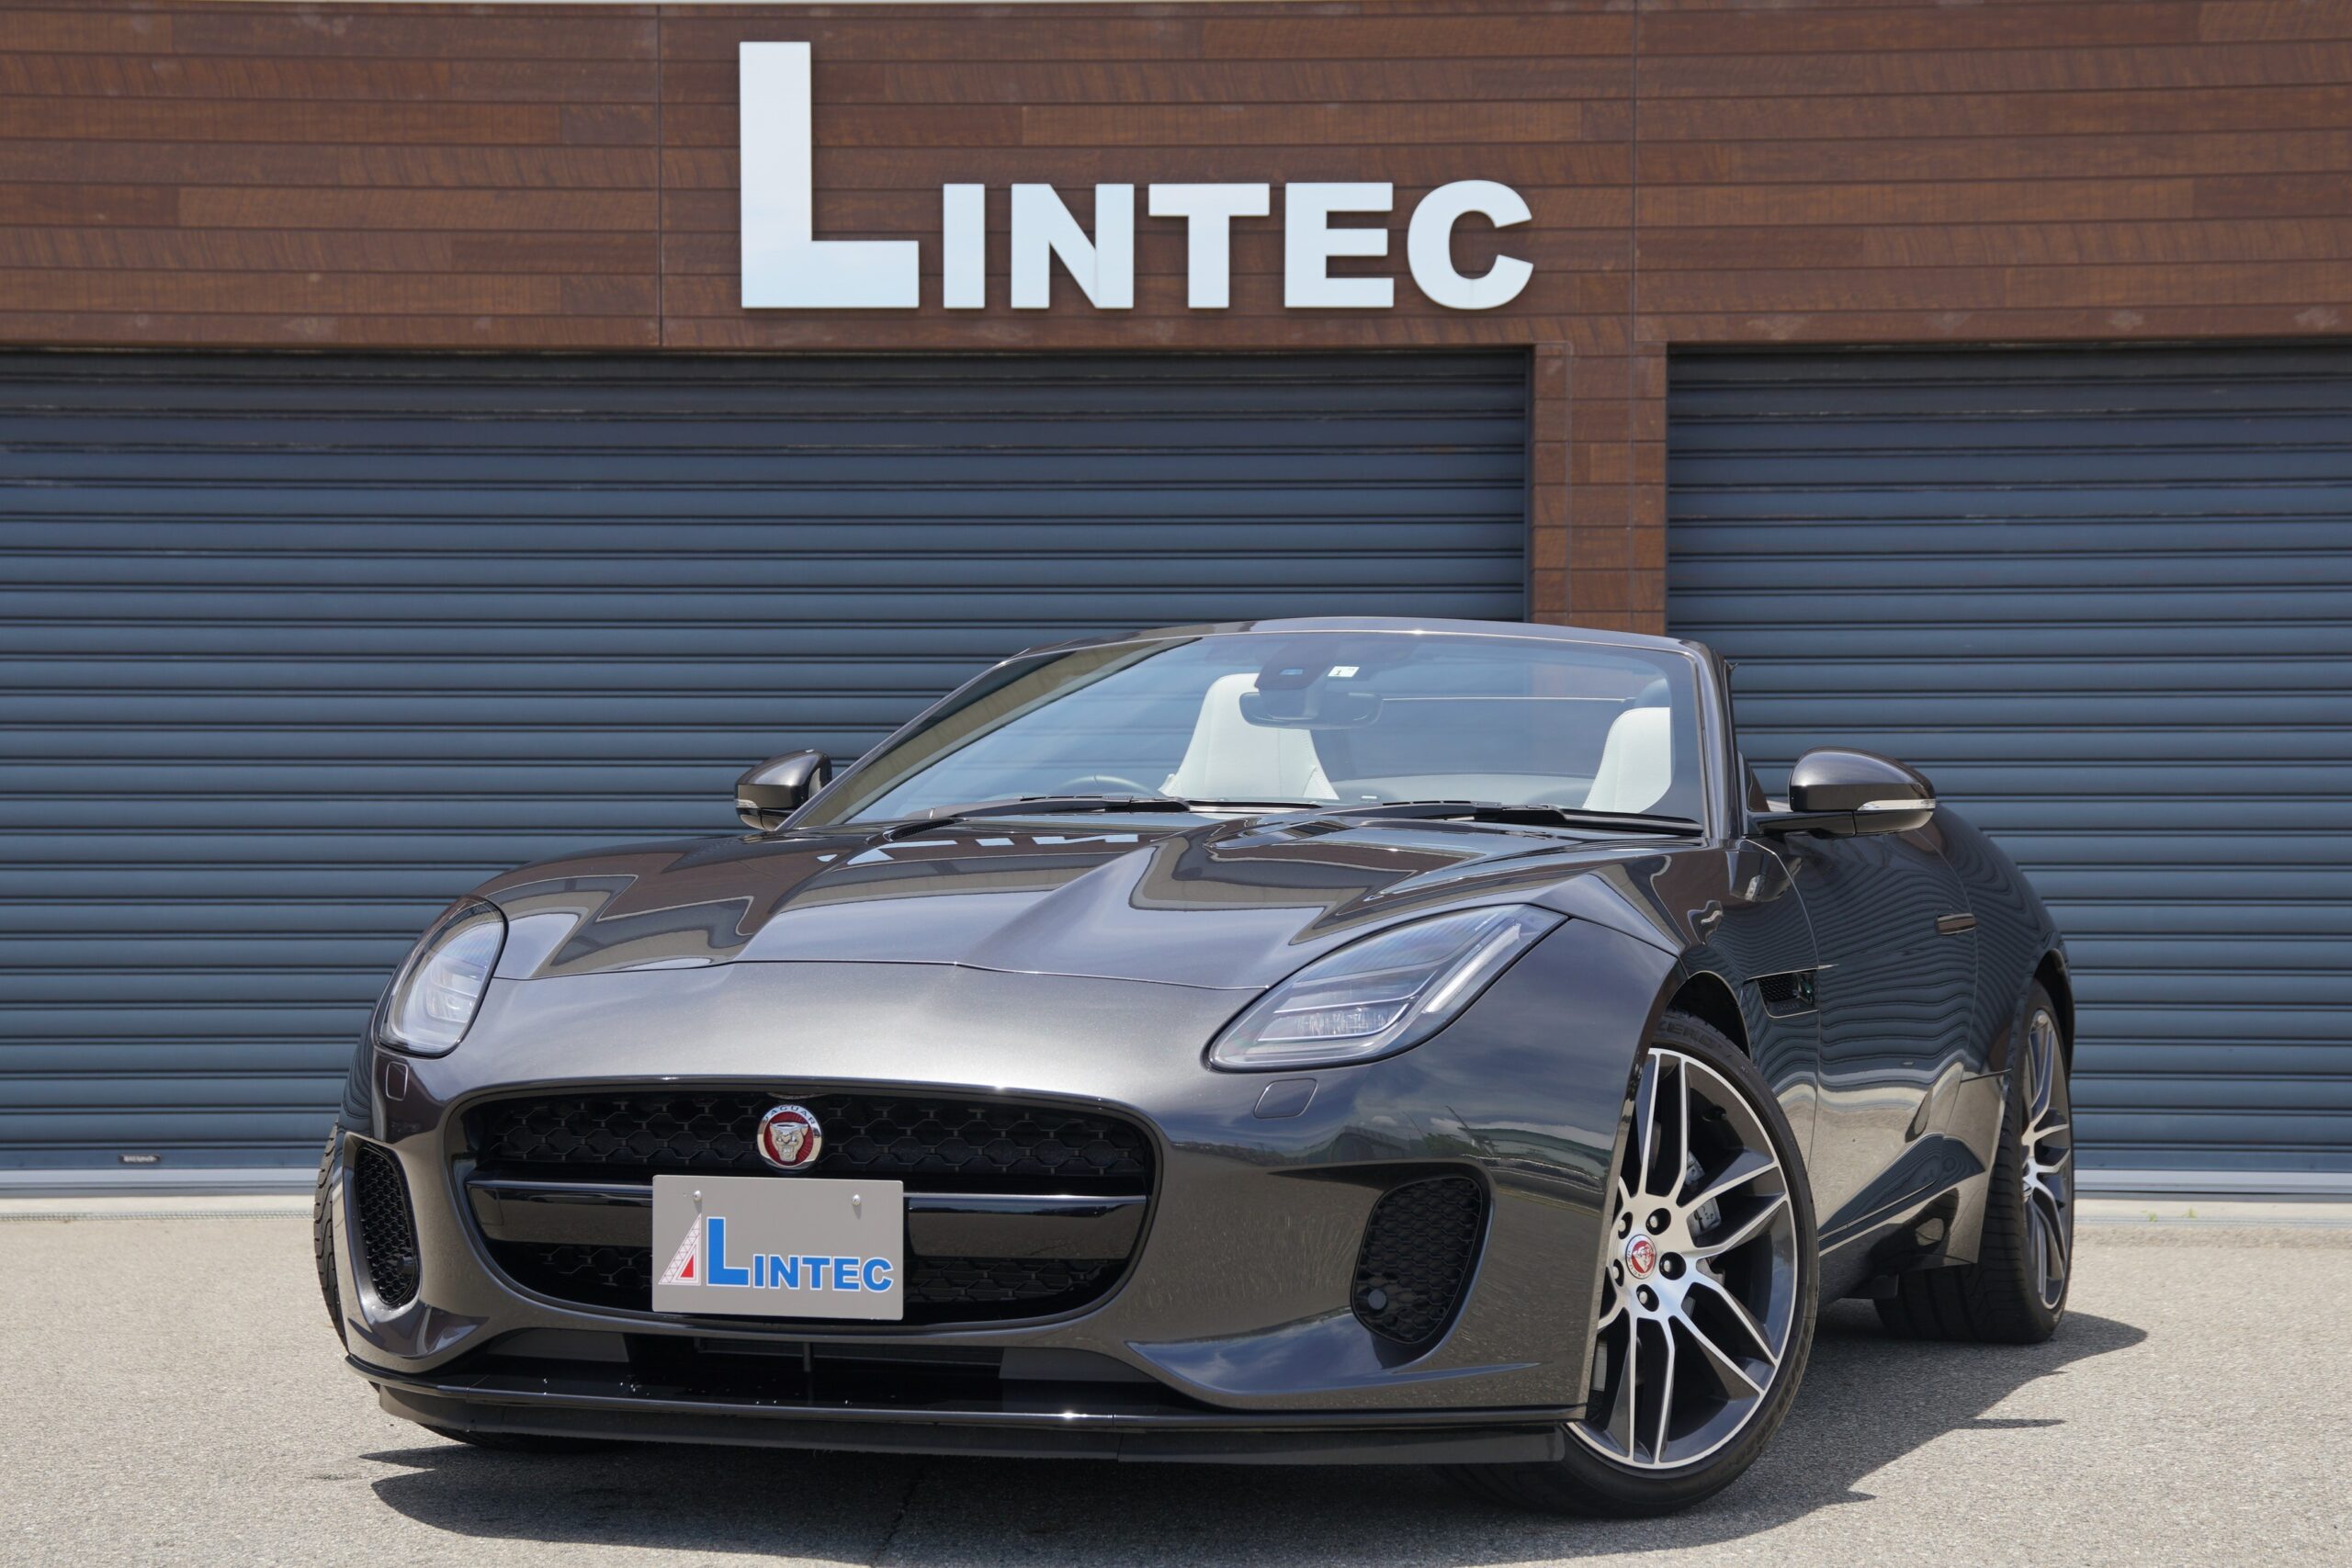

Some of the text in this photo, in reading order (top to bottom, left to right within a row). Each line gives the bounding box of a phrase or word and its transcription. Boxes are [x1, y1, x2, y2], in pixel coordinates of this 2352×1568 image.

[739, 41, 1533, 310] LINTEC
[765, 1106, 816, 1124] JAGUAR
[707, 1216, 893, 1292] LINTEC
